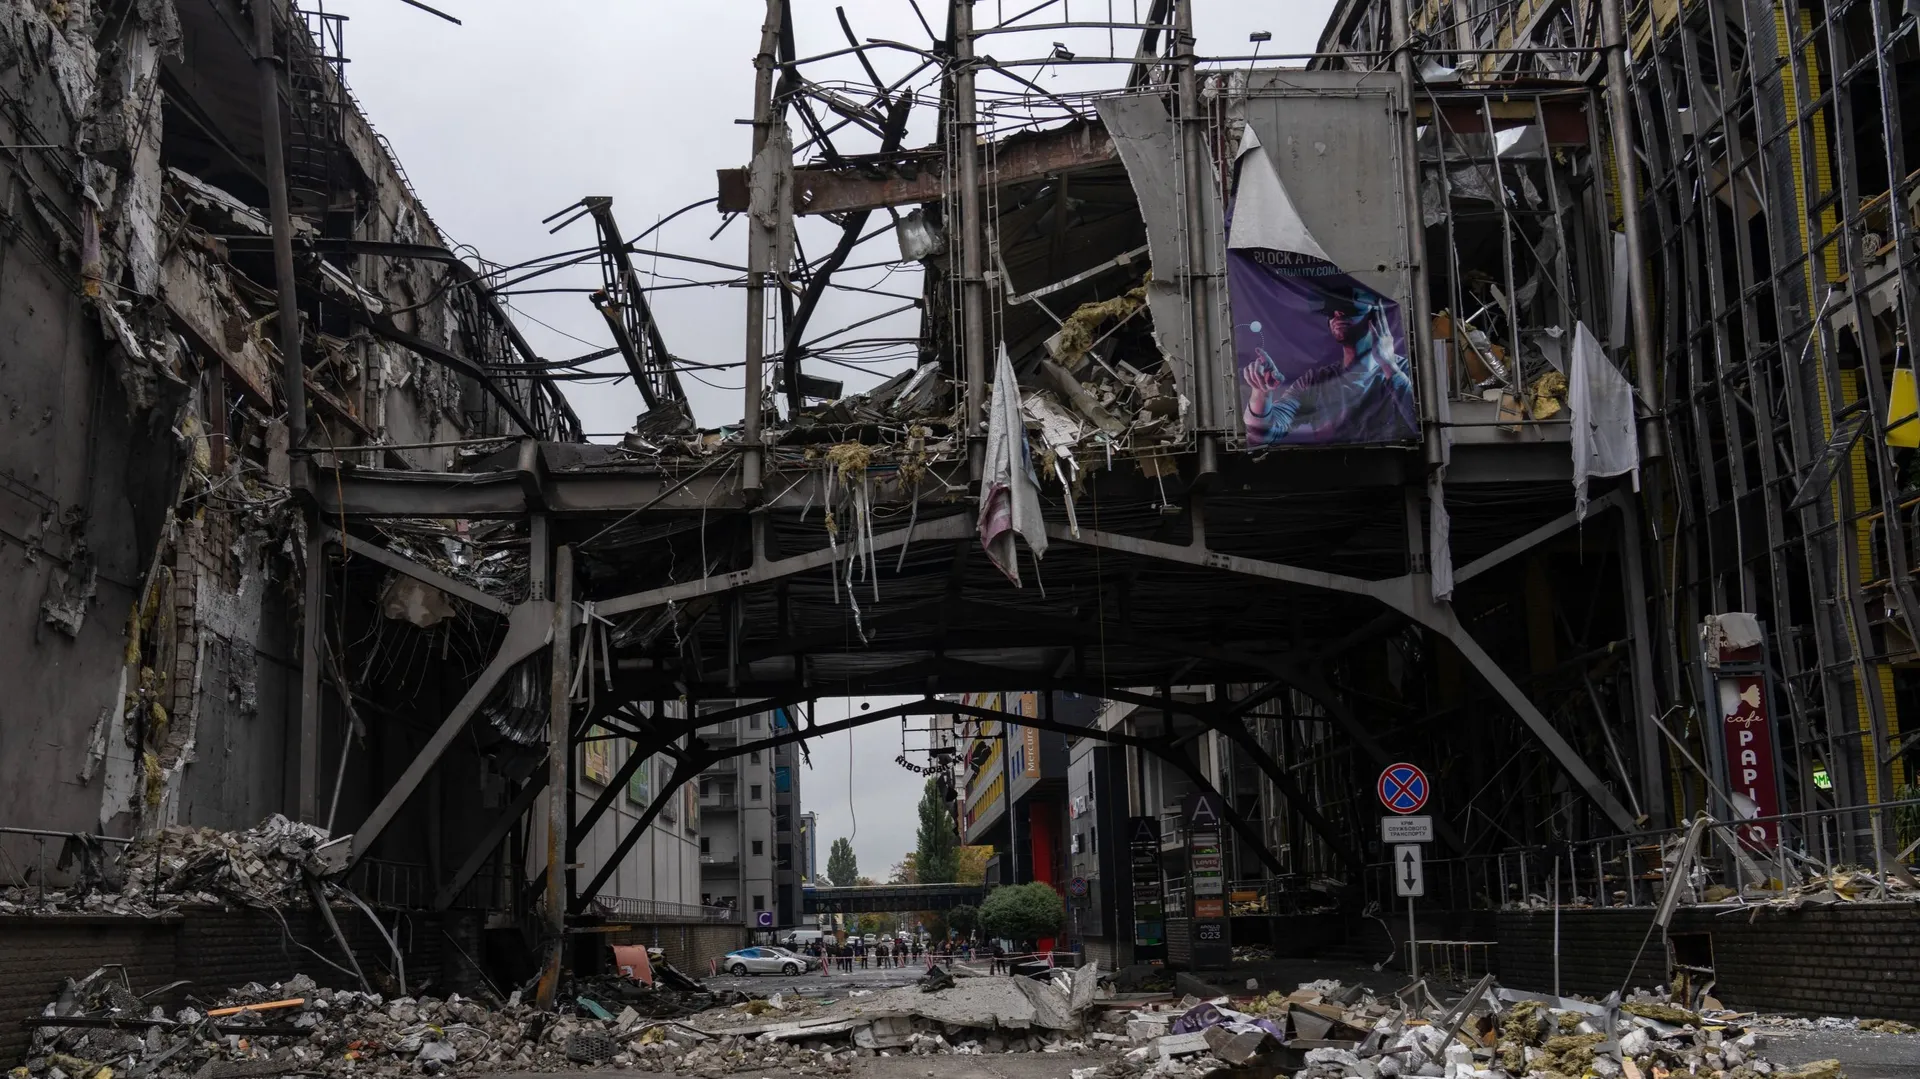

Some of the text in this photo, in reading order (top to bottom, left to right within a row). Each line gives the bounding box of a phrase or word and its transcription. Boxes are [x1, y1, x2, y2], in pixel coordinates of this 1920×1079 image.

[1253, 250, 1292, 265] BLOCK
[1726, 710, 1764, 728] cafe
[1192, 795, 1217, 821] A
[1134, 819, 1154, 841] A
[759, 912, 770, 926] C
